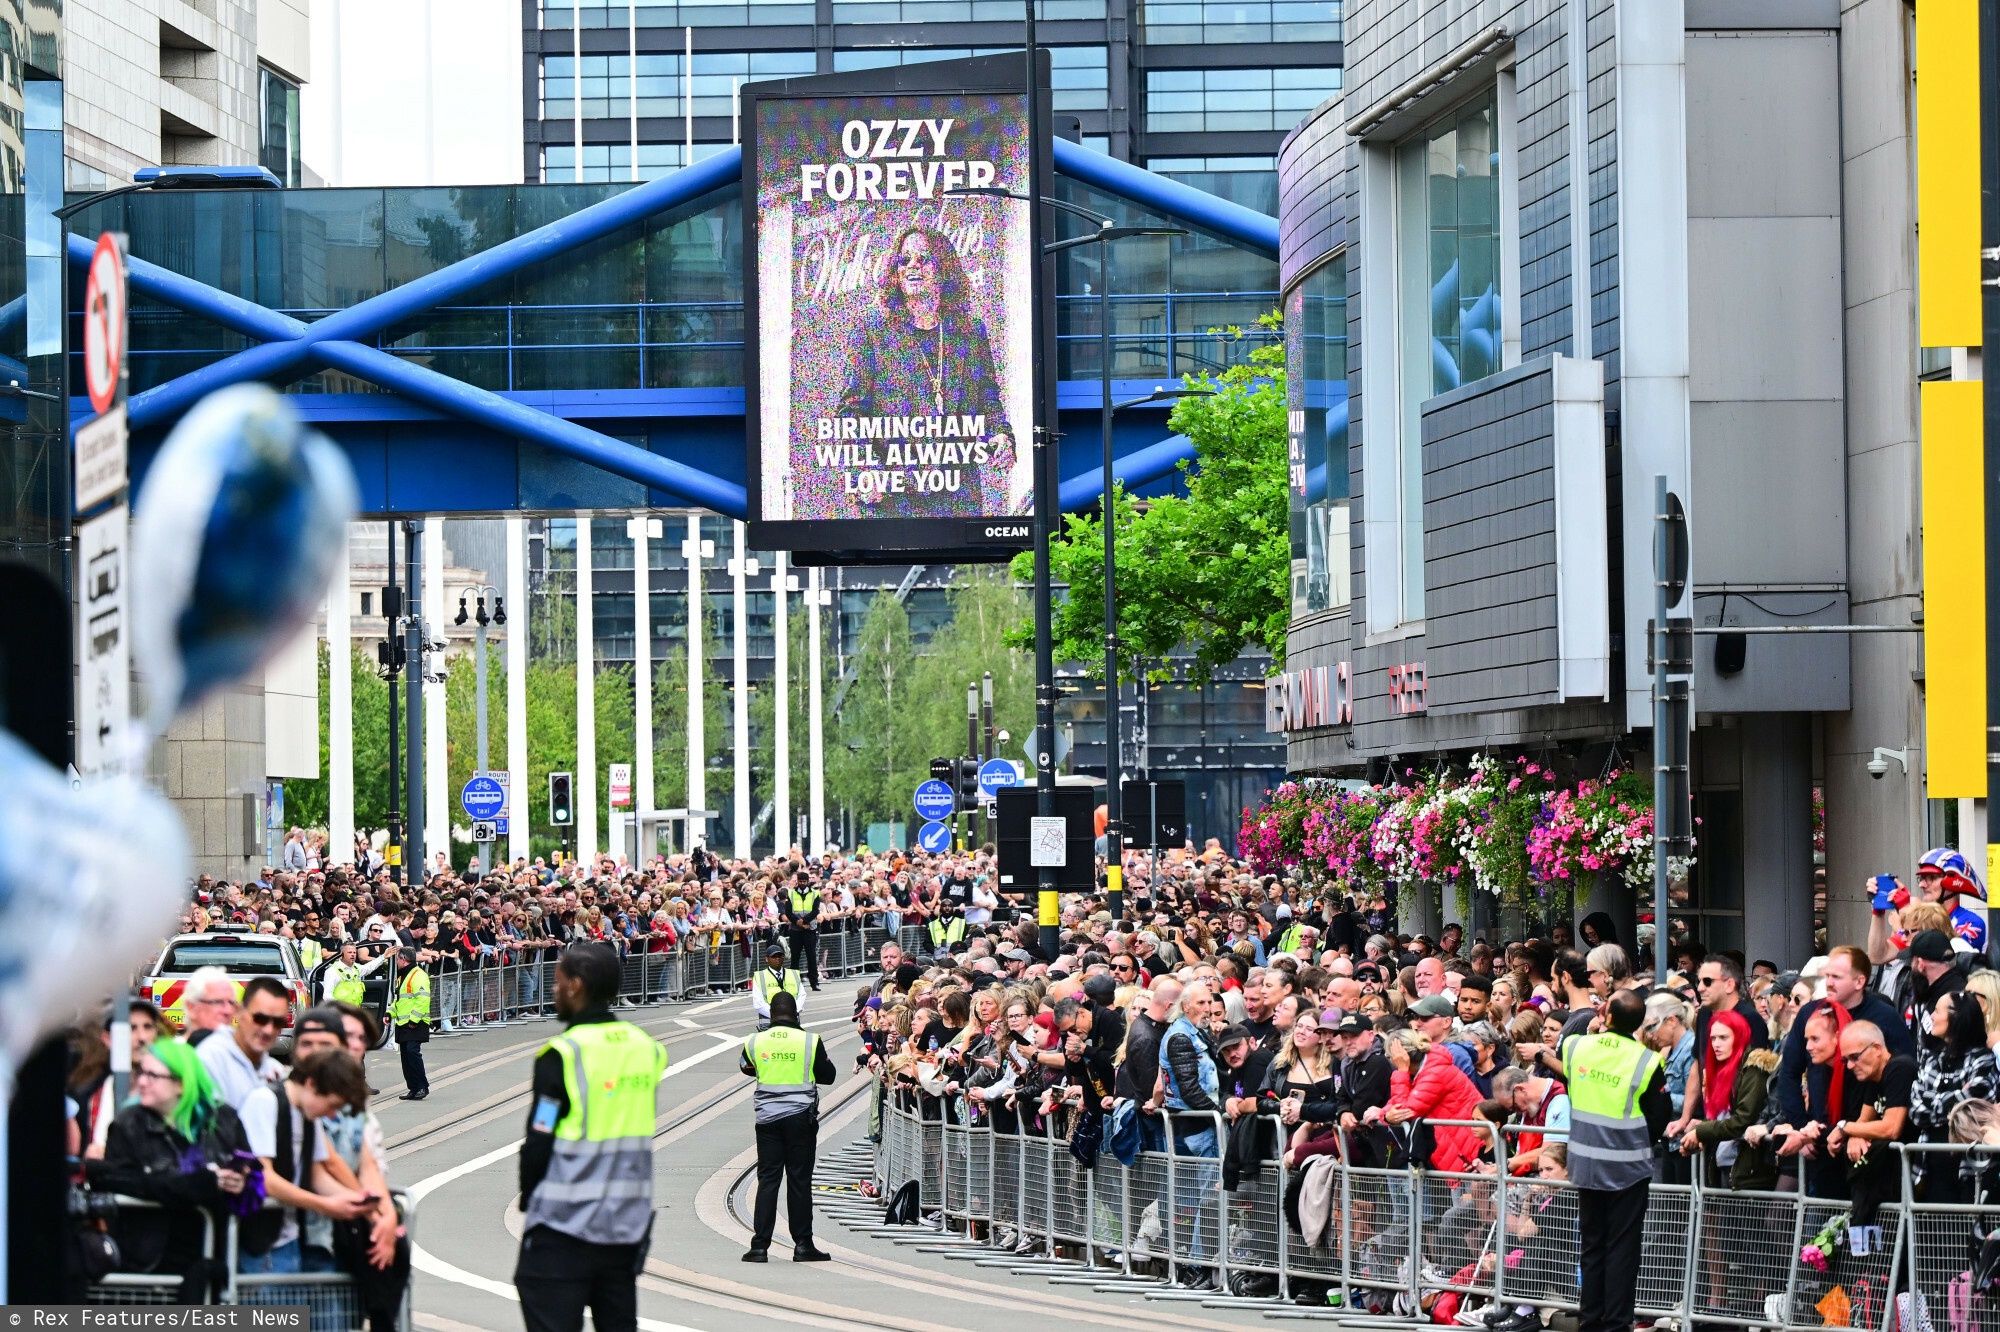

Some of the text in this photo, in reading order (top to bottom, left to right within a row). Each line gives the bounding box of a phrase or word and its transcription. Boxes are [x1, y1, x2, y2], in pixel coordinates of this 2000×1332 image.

[842, 119, 955, 158] OZZY
[801, 161, 995, 201] FOREVER
[817, 415, 985, 439] BIRMINGHAM
[815, 442, 989, 467] WILL ALWAYS
[844, 470, 961, 493] LOVE YOU
[985, 526, 1029, 537] OCEAN
[770, 1031, 788, 1039] 450
[1597, 1037, 1620, 1049] 483
[771, 1051, 796, 1062] snsg
[1589, 1068, 1621, 1088] snsg
